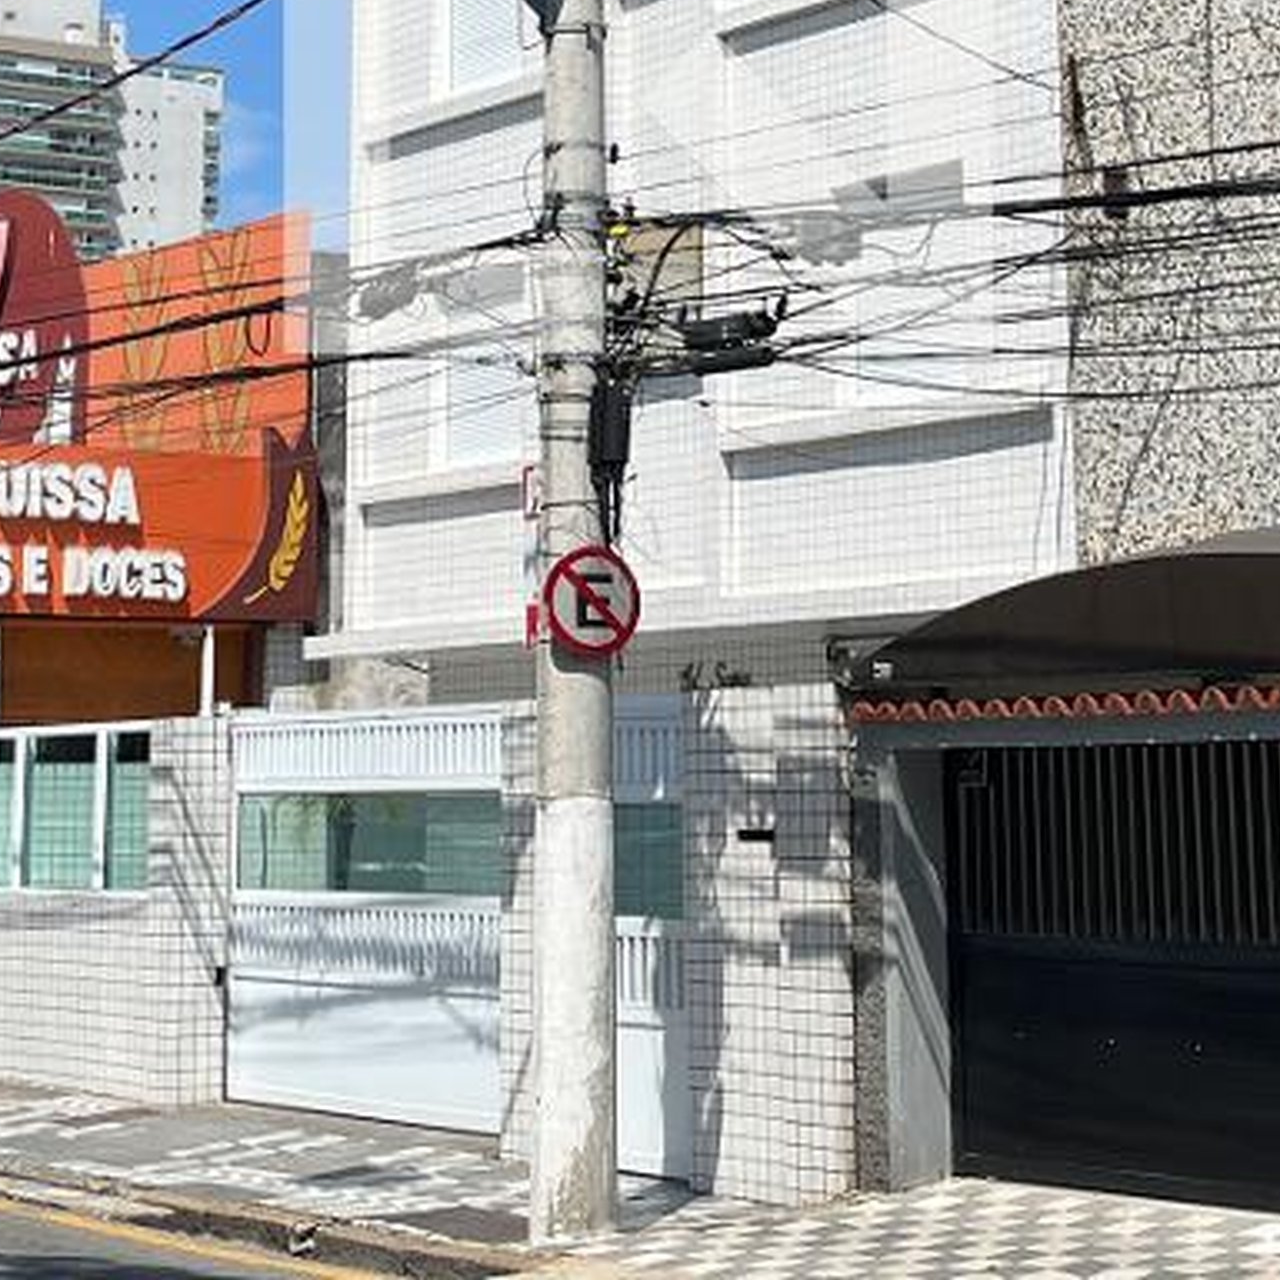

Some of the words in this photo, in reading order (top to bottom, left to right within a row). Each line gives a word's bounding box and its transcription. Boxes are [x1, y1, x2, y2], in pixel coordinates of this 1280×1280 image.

[22, 544, 49, 595] E
[62, 544, 188, 603] DOCES
[576, 572, 613, 628] E
